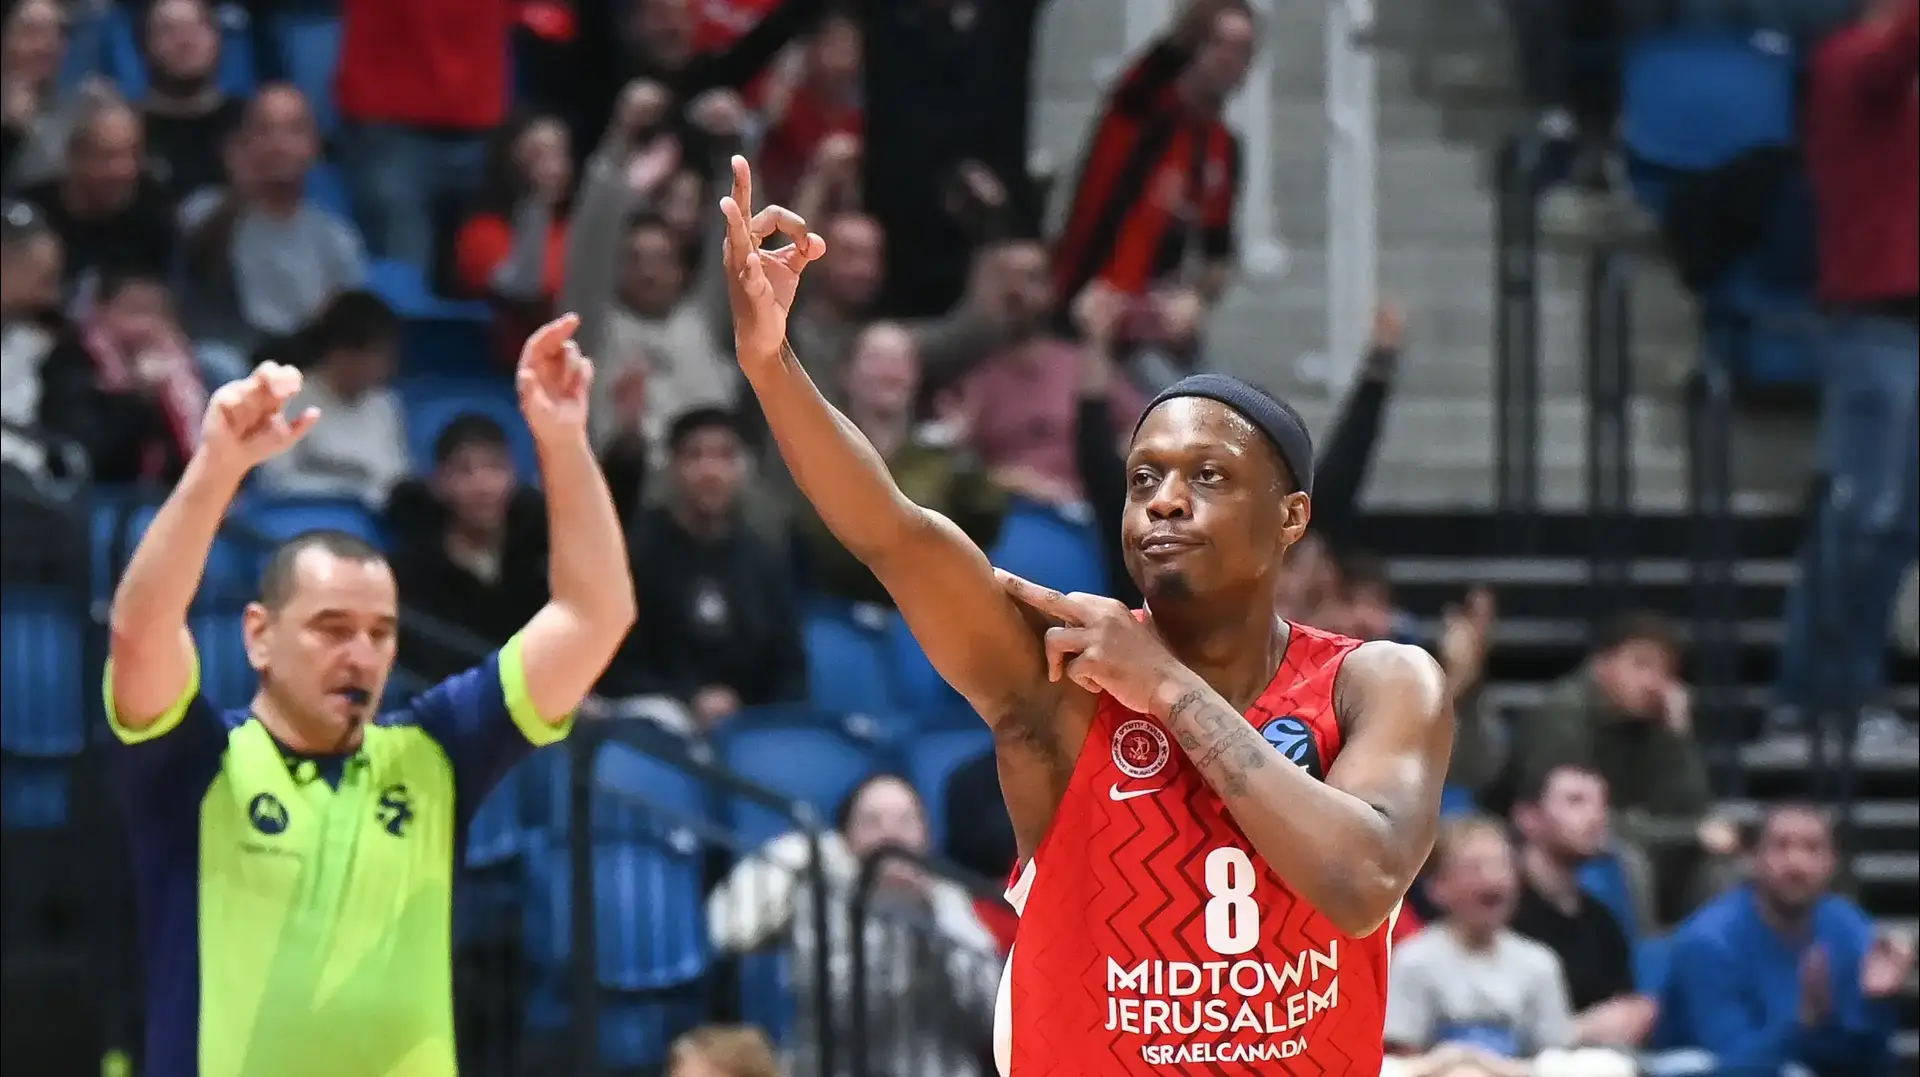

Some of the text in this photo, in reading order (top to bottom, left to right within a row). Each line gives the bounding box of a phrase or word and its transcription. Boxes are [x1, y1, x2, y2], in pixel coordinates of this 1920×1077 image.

[1205, 846, 1260, 955] 8
[1107, 939, 1338, 997] MIDTOWN
[1104, 975, 1339, 1035] JERUSALEM
